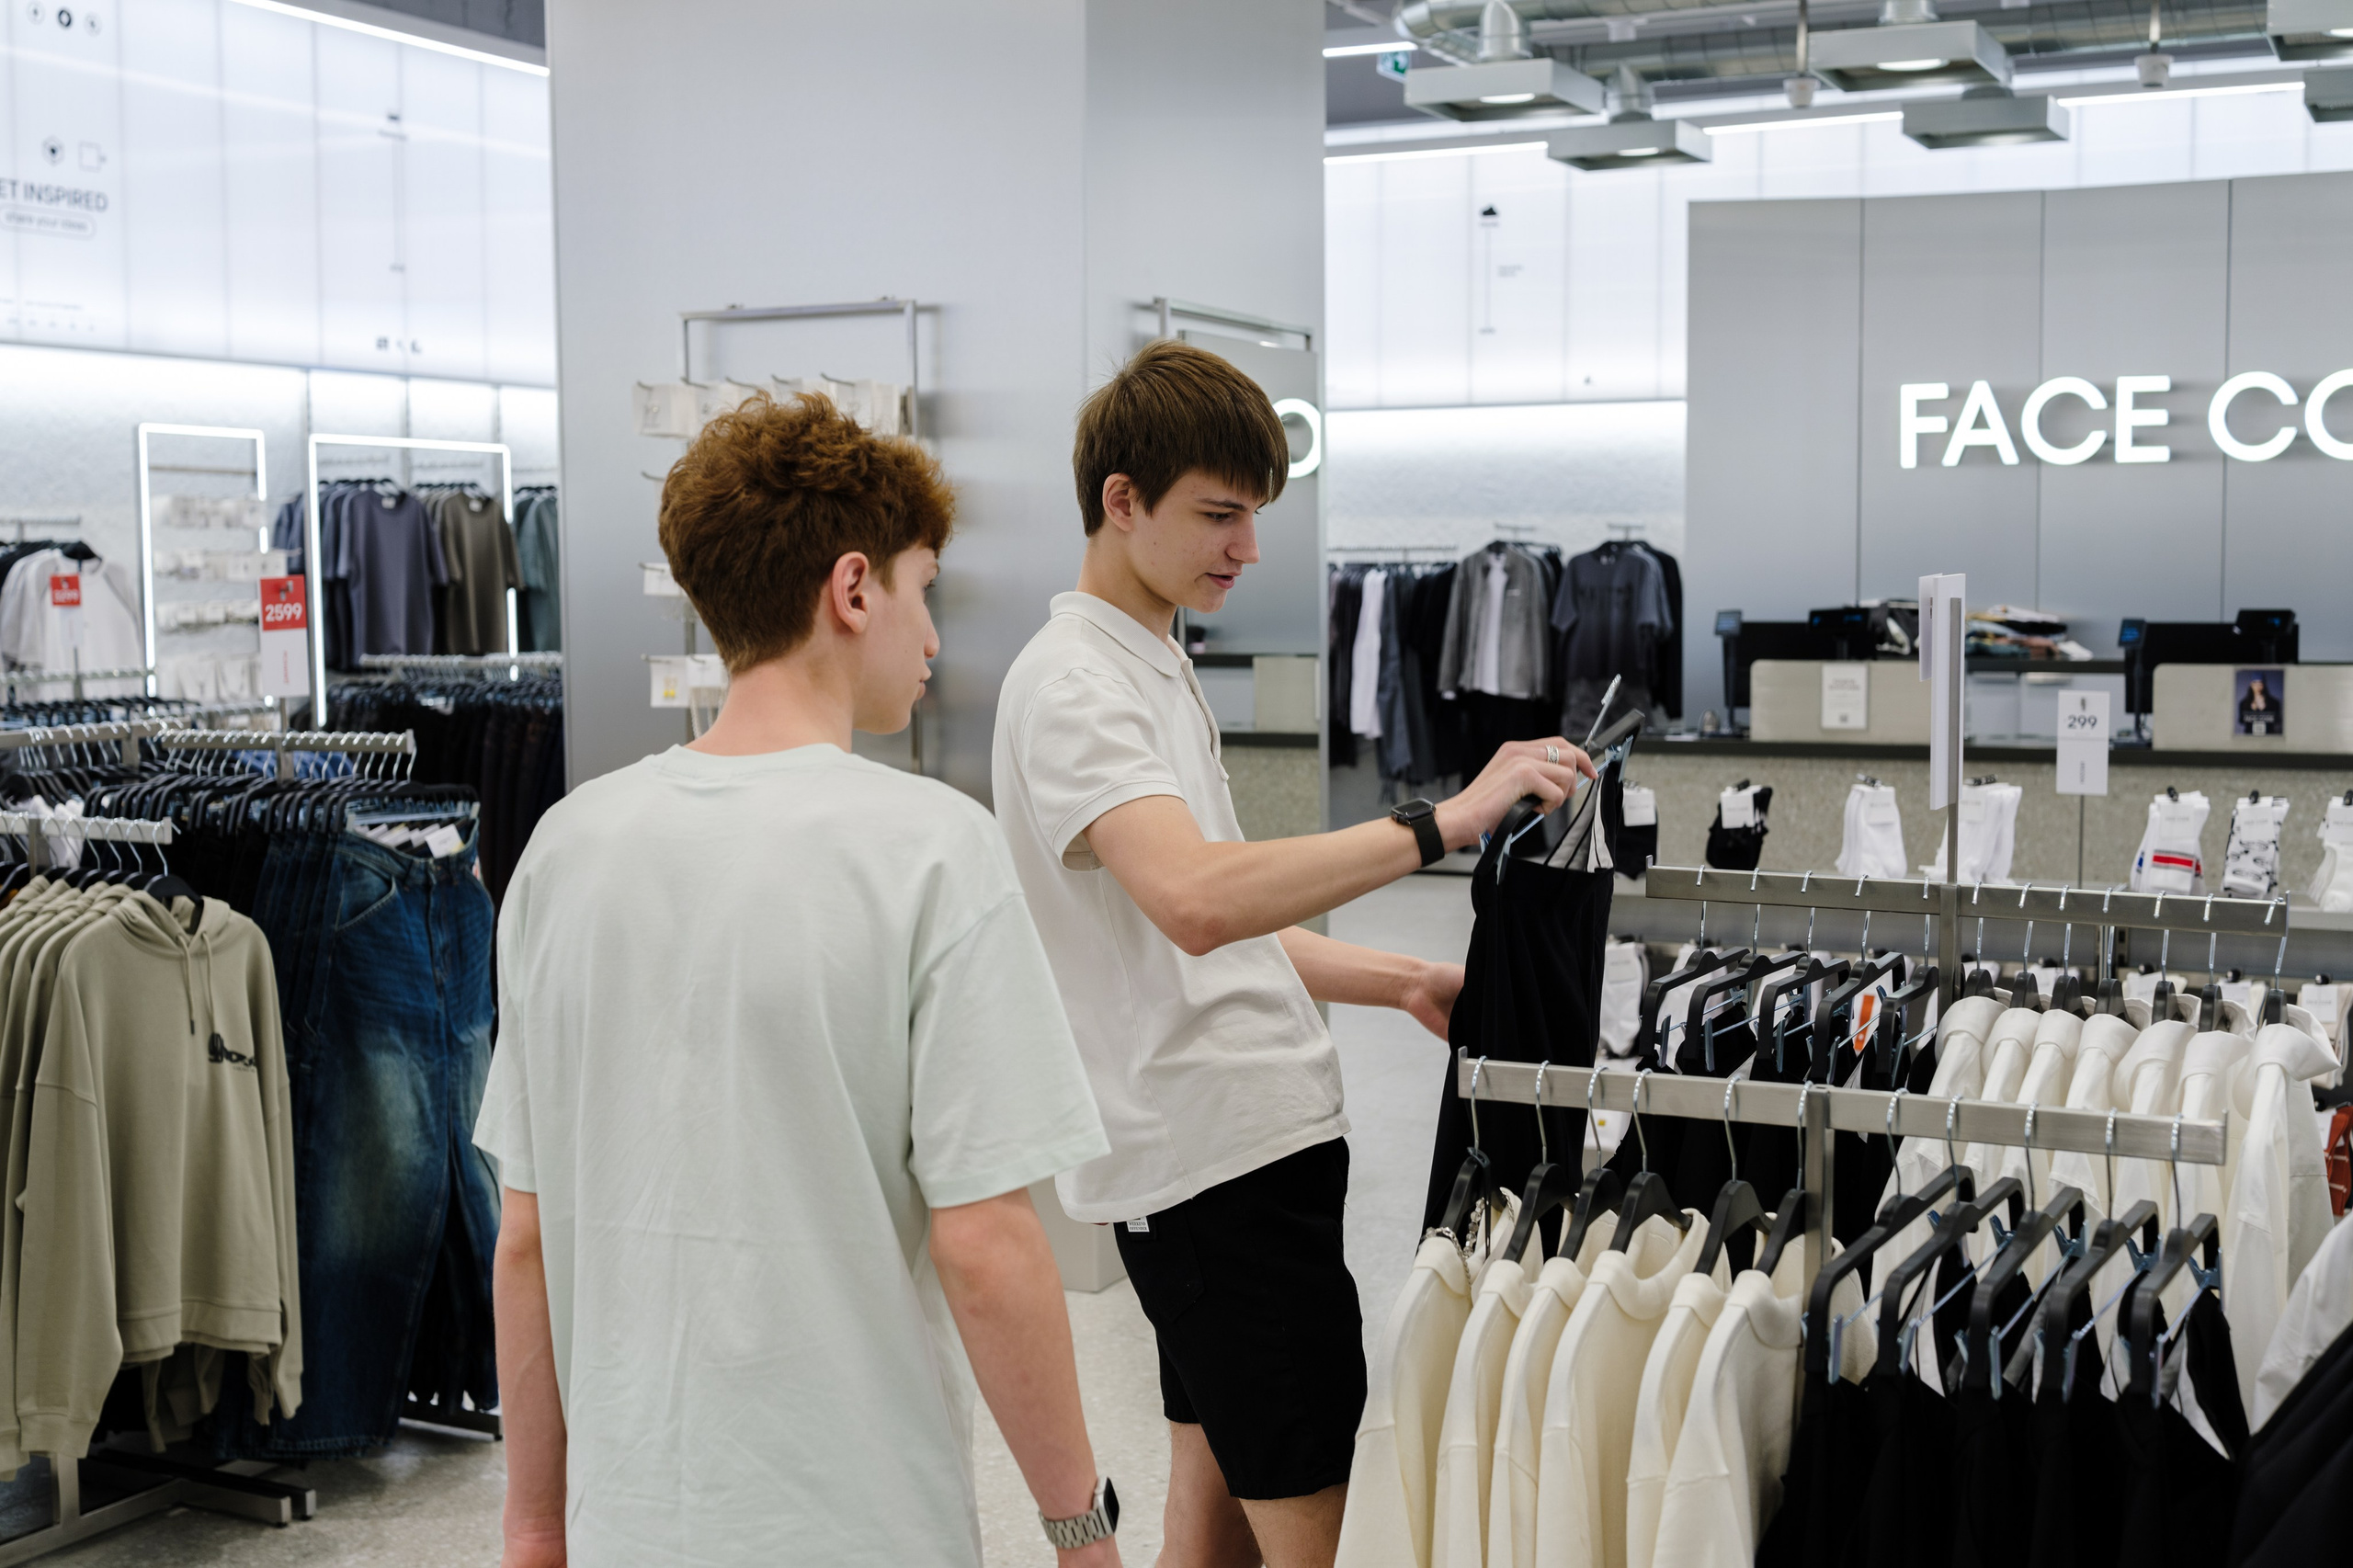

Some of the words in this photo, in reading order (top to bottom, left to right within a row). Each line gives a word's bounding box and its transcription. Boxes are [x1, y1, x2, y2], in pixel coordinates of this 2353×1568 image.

[23, 181, 108, 213] INSPIRED
[1900, 374, 2171, 469] FACE
[265, 602, 303, 622] 2599
[2068, 715, 2097, 729] 299
